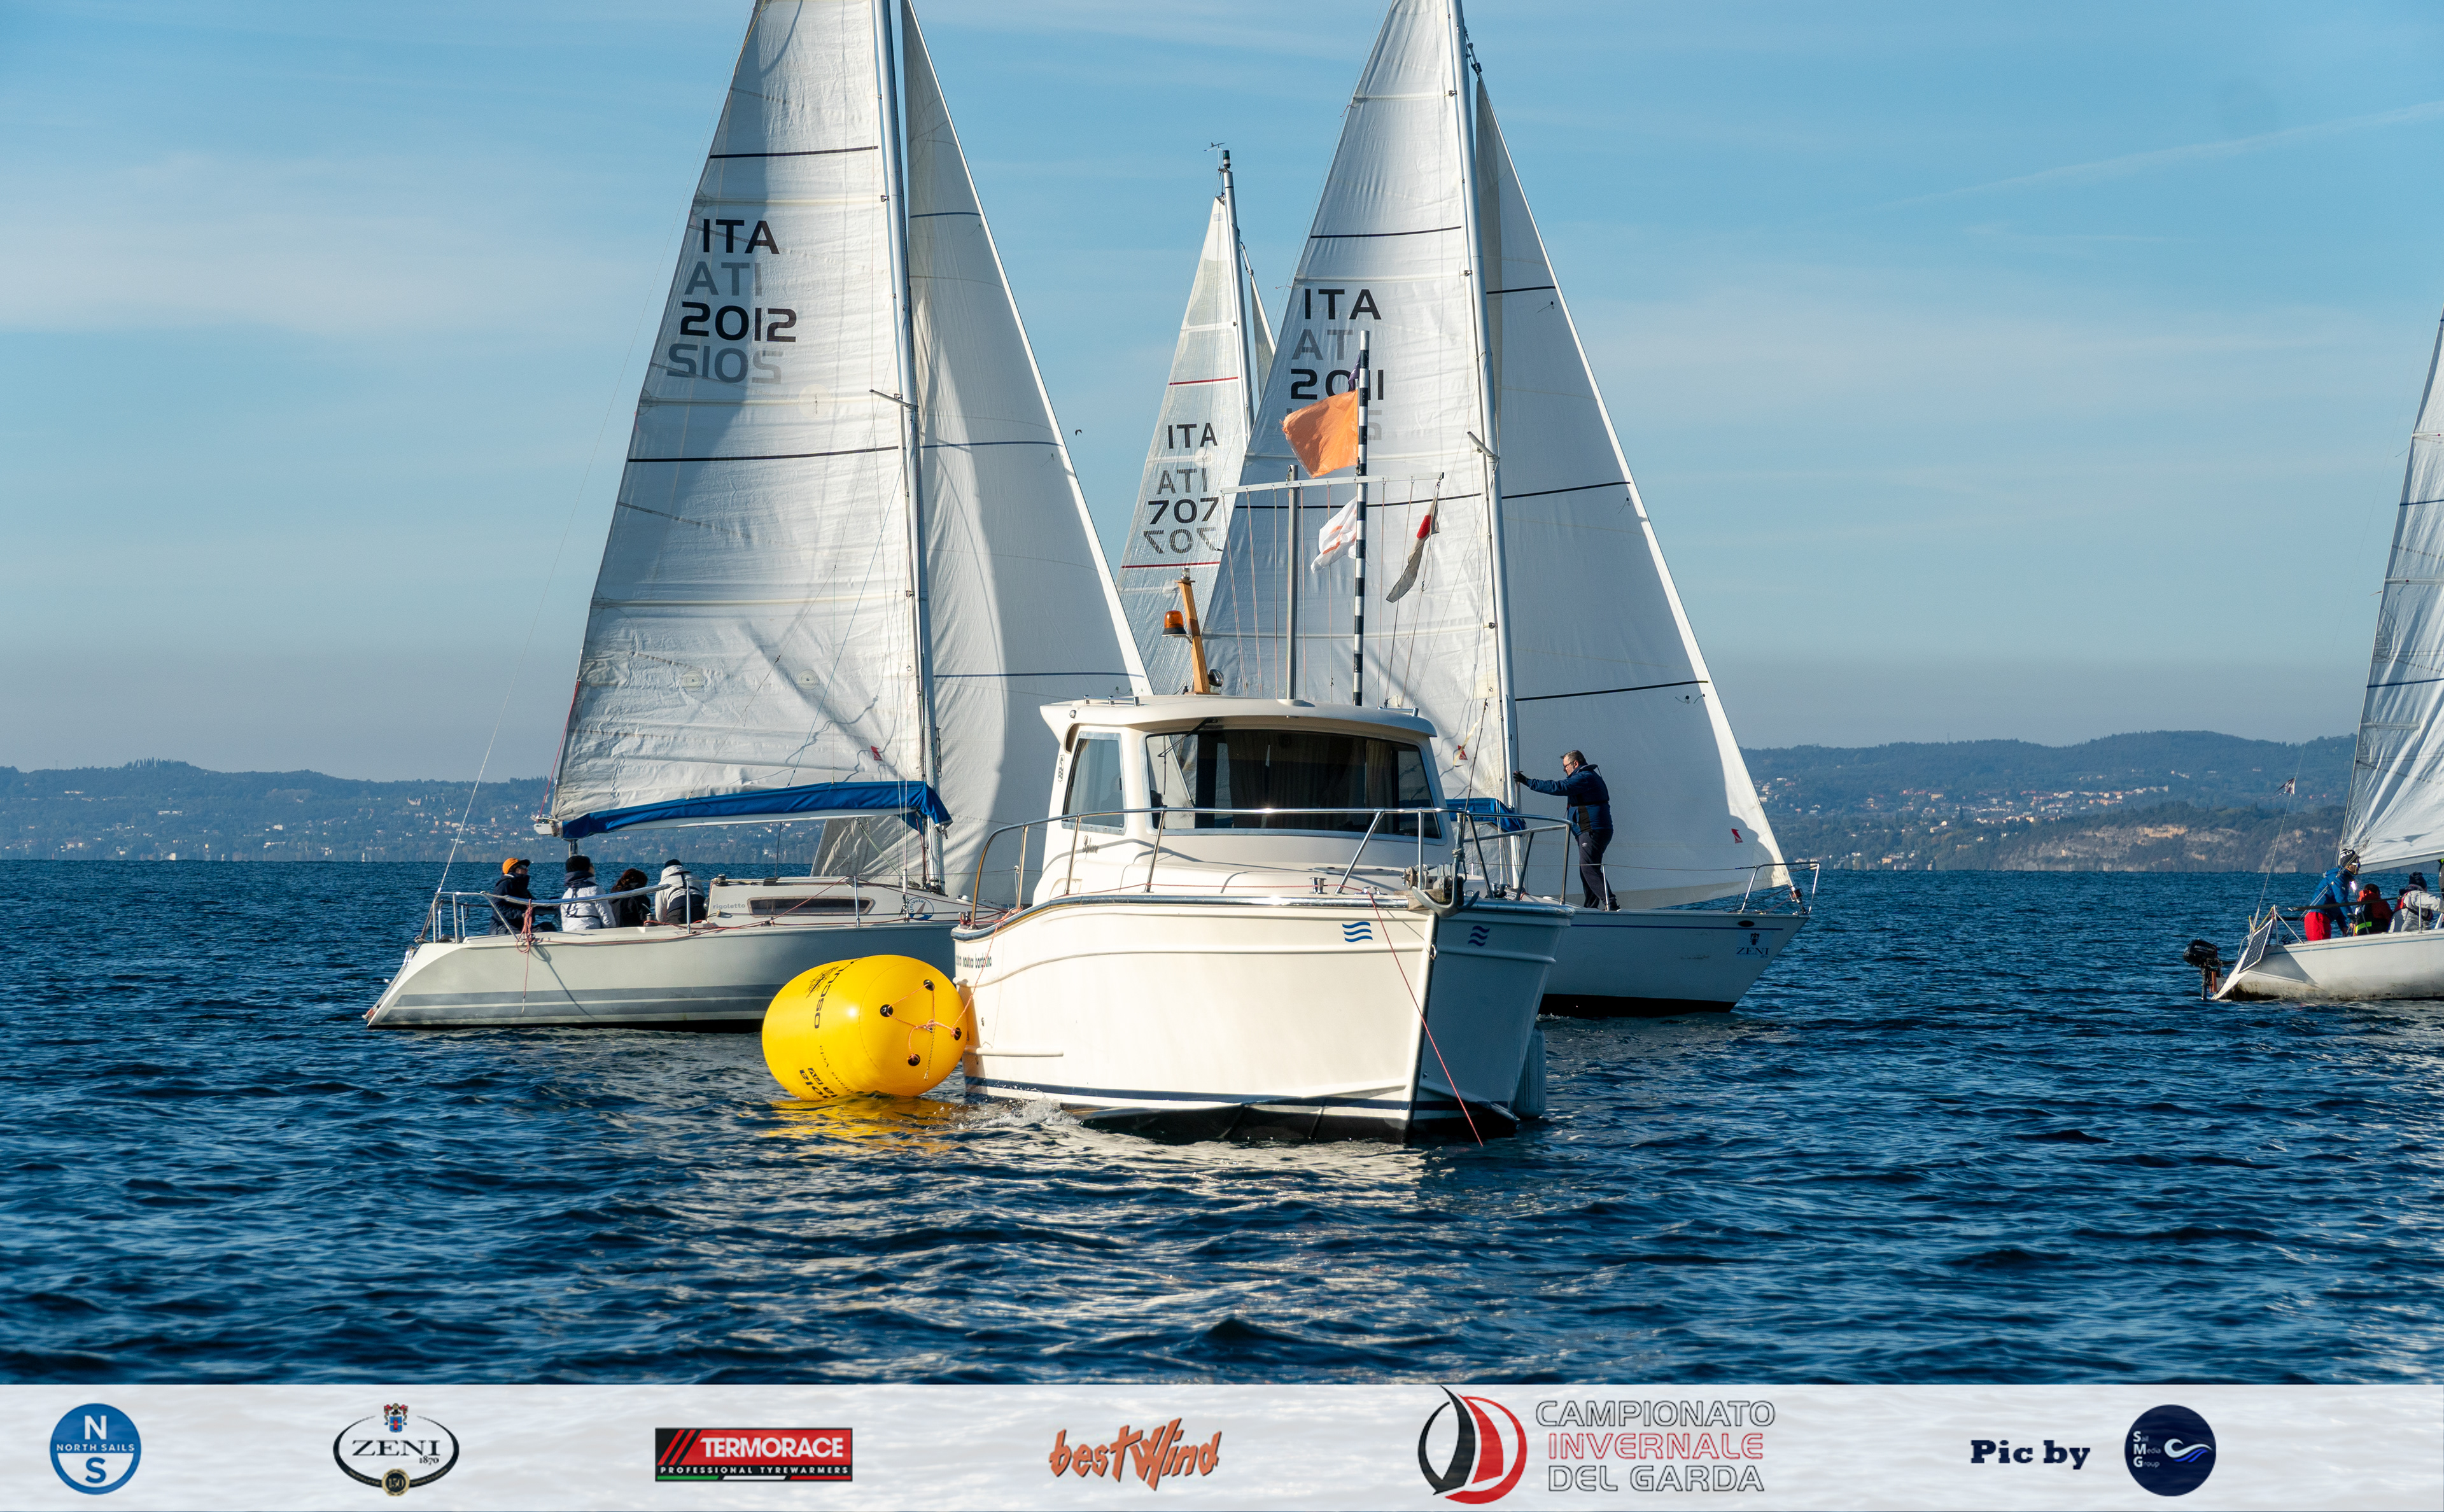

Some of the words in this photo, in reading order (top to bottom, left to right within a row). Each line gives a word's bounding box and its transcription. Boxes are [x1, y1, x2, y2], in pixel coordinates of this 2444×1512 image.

[703, 218, 780, 255] ITA
[1305, 288, 1382, 320] ITA
[680, 301, 797, 342] 2012
[1167, 423, 1218, 449] ITA
[1148, 496, 1219, 525] 707
